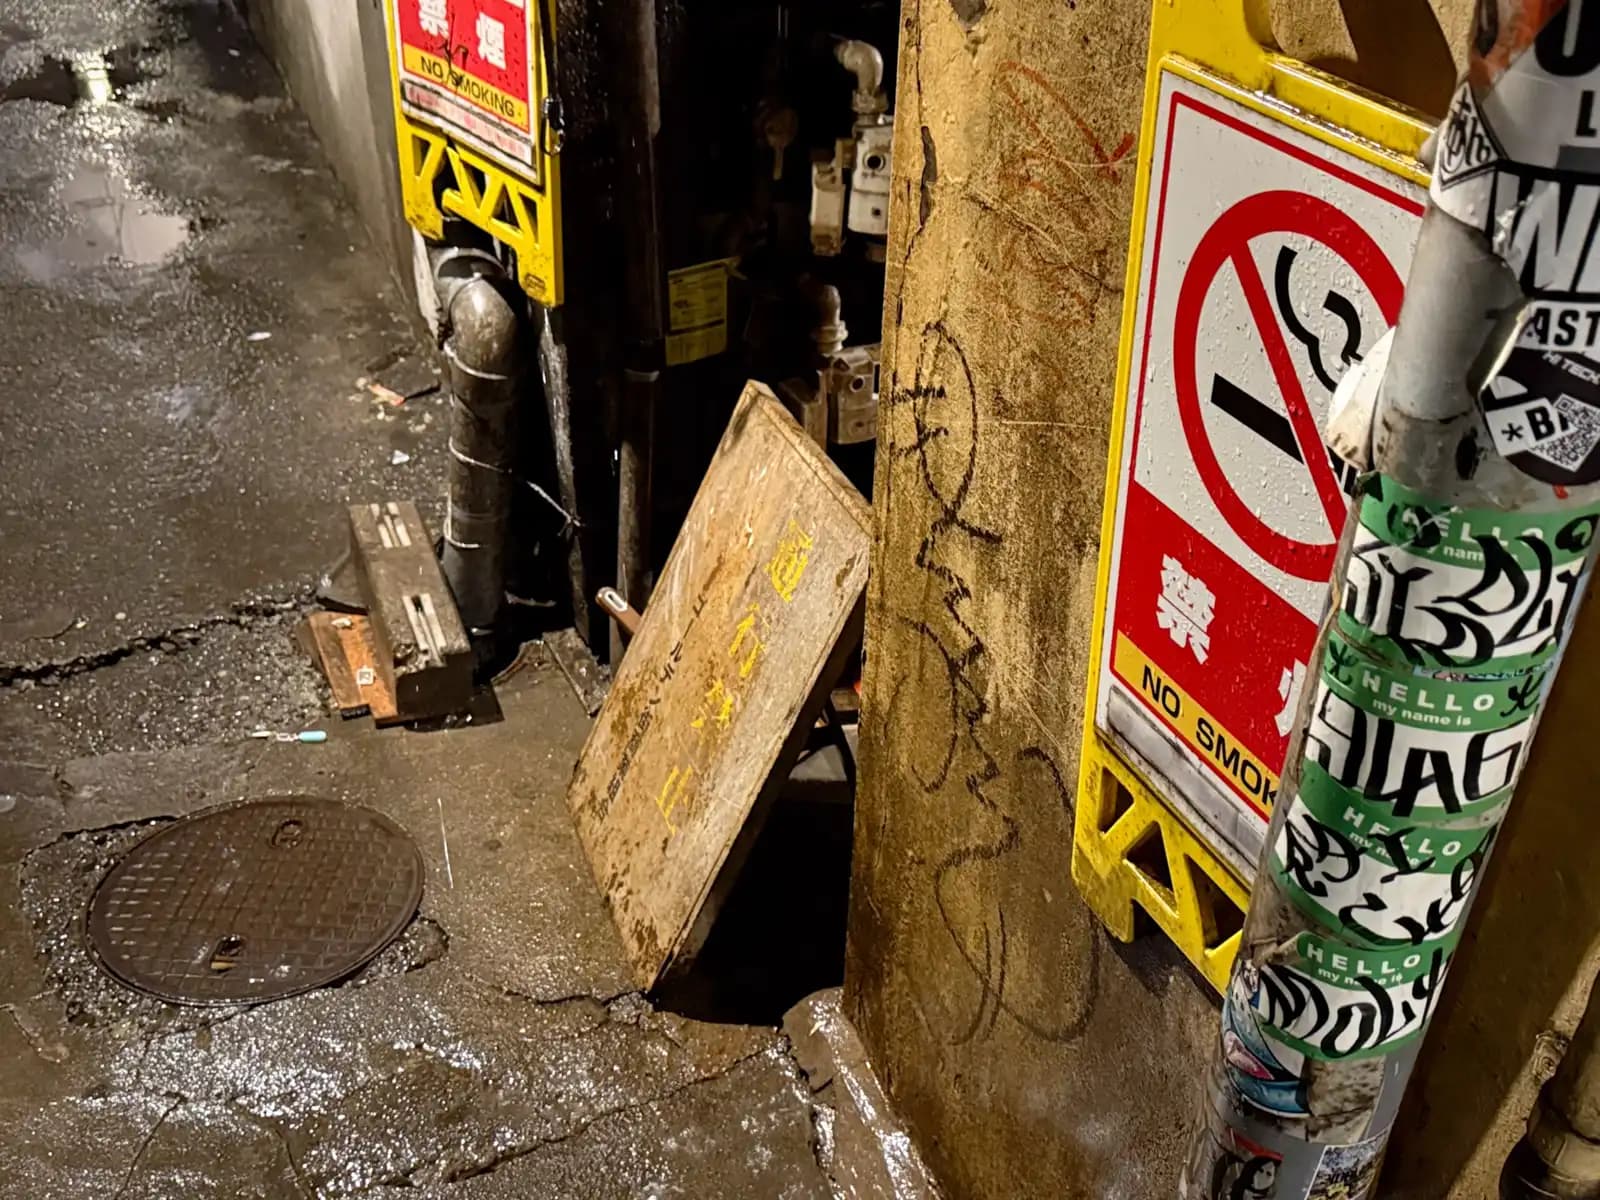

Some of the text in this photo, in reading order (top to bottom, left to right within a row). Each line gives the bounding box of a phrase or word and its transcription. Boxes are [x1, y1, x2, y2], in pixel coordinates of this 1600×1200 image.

[420, 56, 515, 118] NO SMOKING
[1142, 664, 1182, 719] NO
[1362, 670, 1495, 712] HELLO
[1373, 698, 1472, 728] my name is
[1306, 943, 1422, 975] HELLO
[1318, 967, 1340, 982] my
